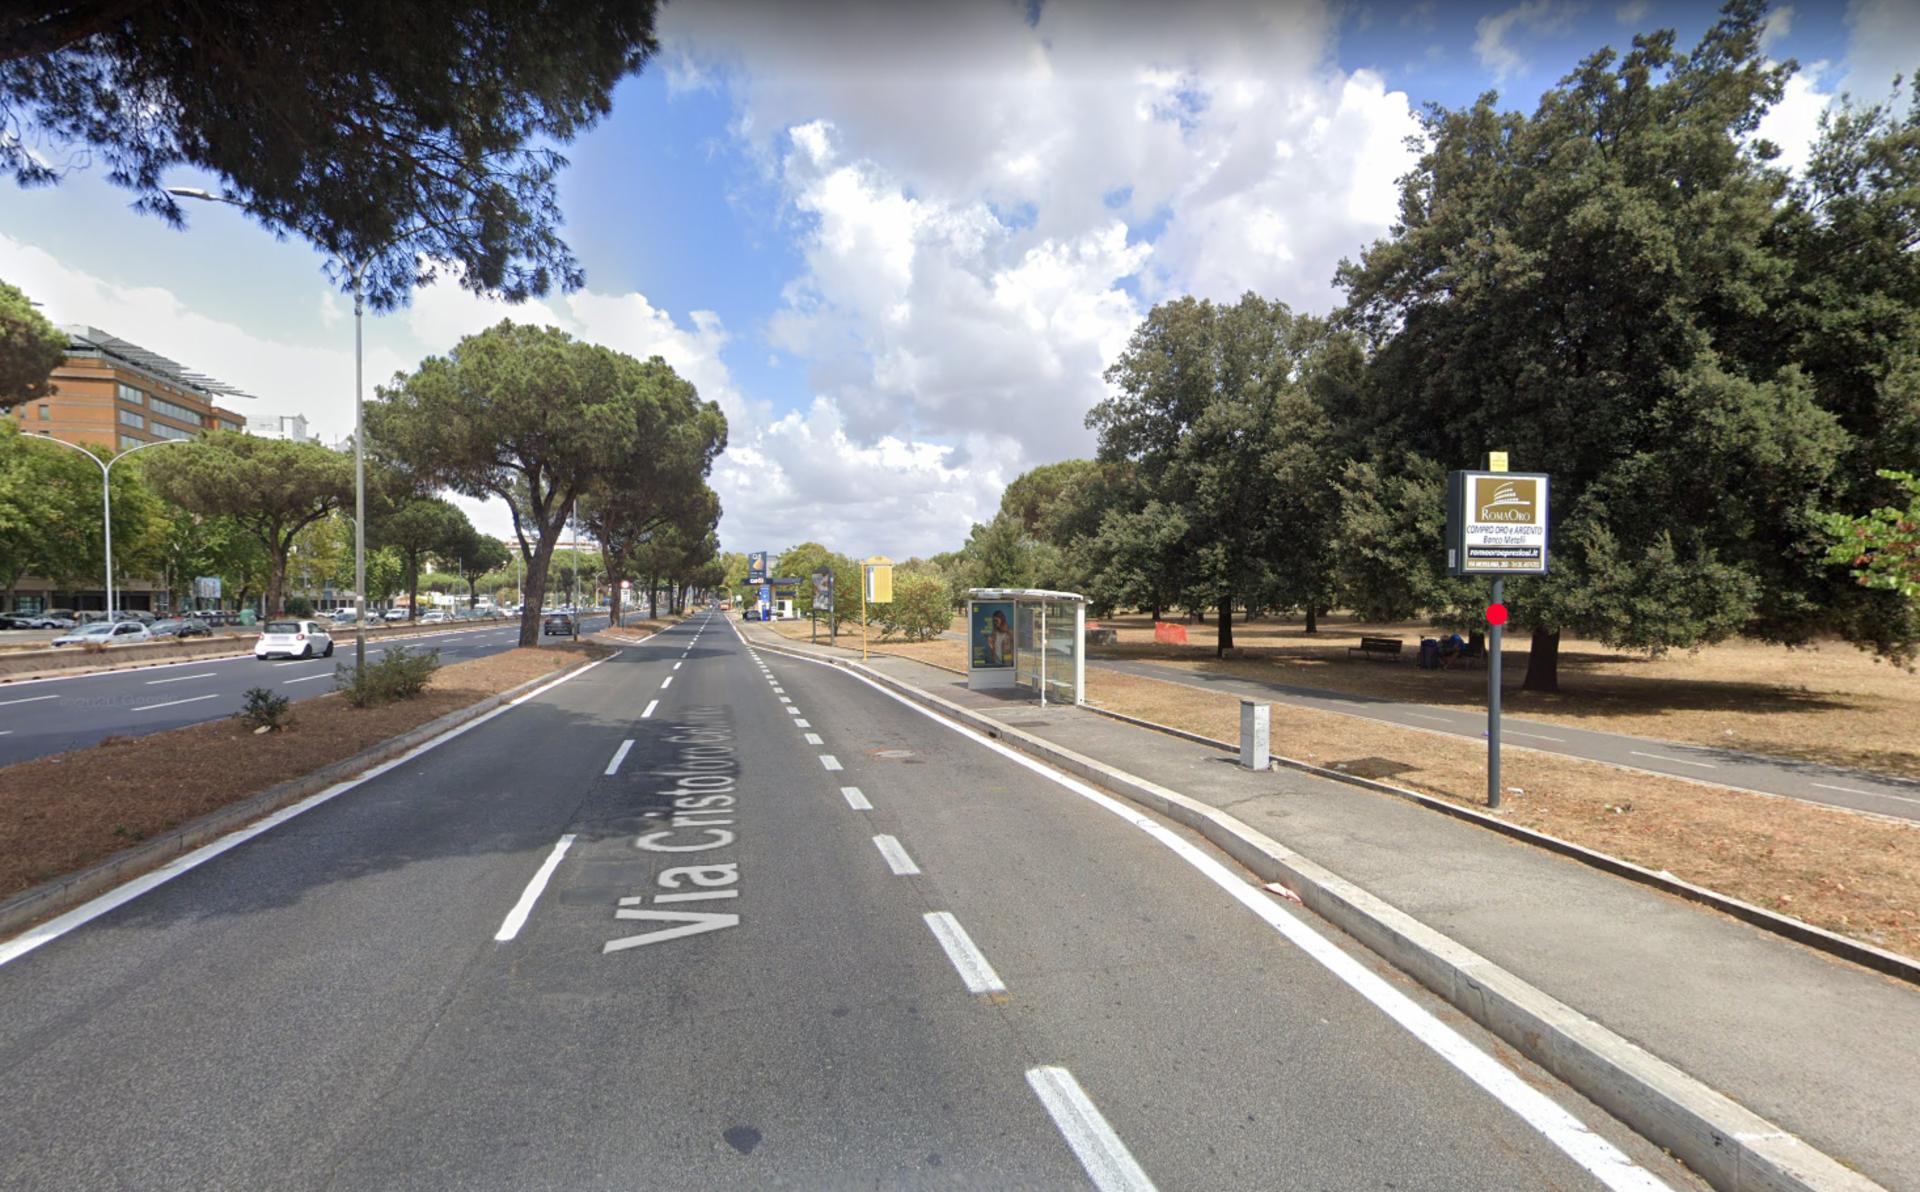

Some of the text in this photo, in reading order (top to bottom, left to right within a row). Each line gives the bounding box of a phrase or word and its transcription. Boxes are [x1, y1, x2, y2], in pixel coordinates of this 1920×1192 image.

[1467, 525, 1494, 534] COMPRO
[1495, 526, 1508, 534] ORO
[1513, 526, 1542, 535] ARGENTO
[1483, 536, 1503, 544] Banco
